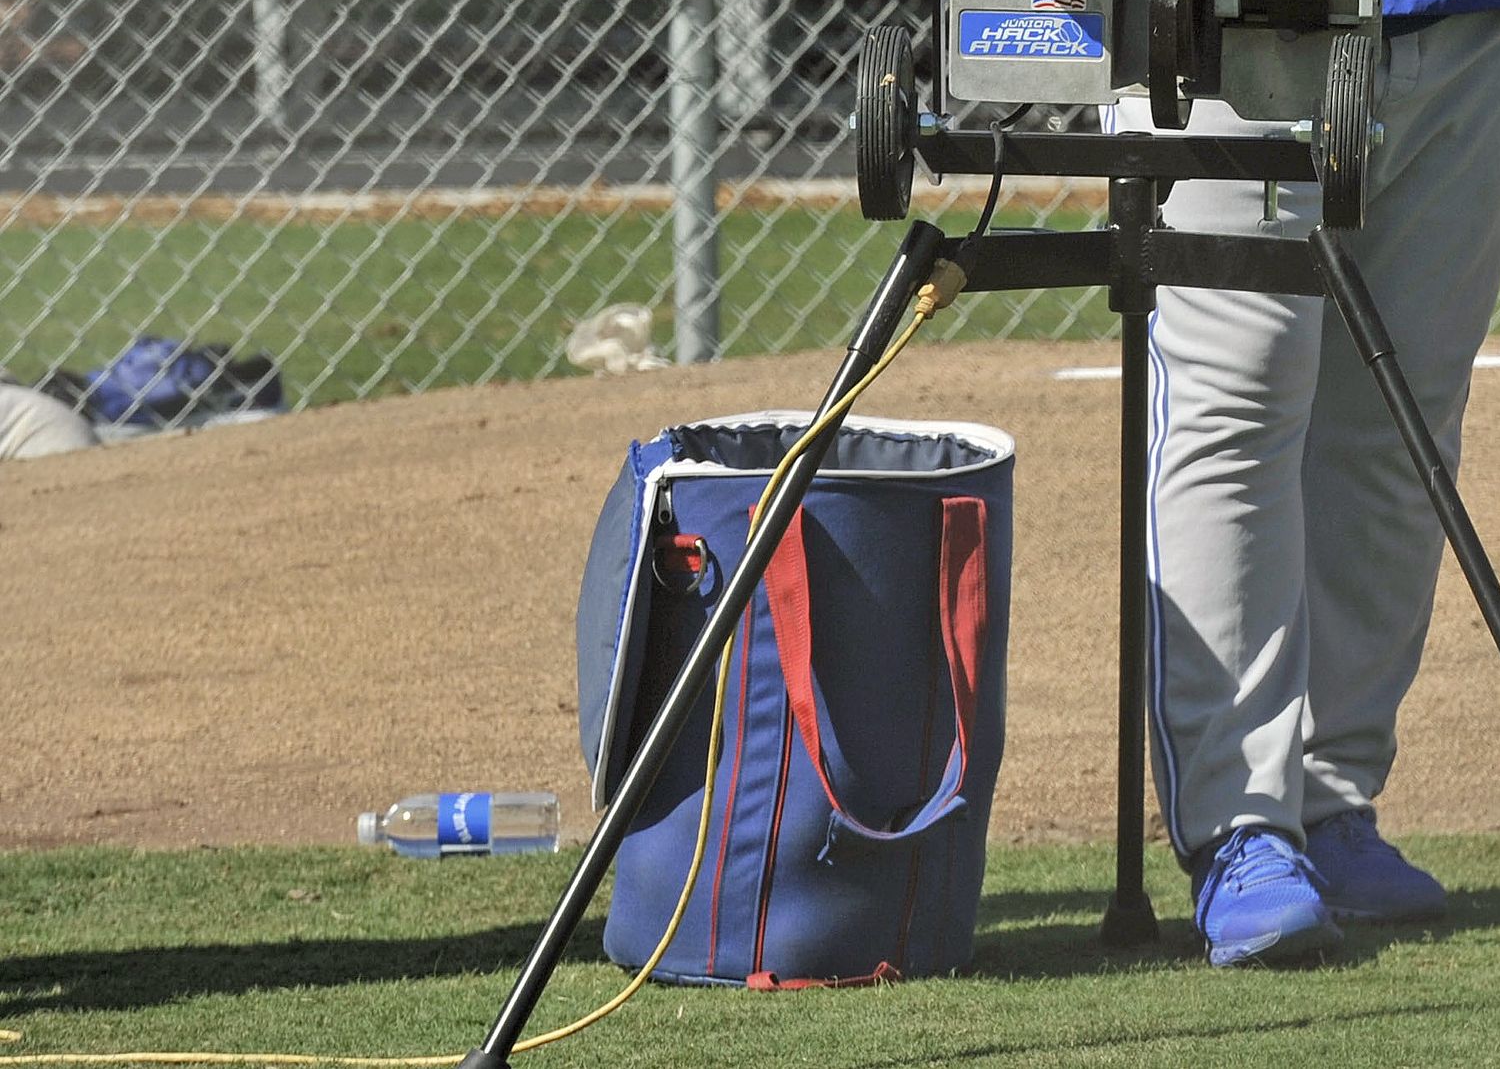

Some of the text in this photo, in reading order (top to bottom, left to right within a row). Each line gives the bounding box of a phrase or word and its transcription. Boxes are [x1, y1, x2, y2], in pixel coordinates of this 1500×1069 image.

[1001, 19, 1053, 28] JUNIOR
[981, 27, 1061, 41] HACK
[969, 40, 1089, 54] ATTACK
